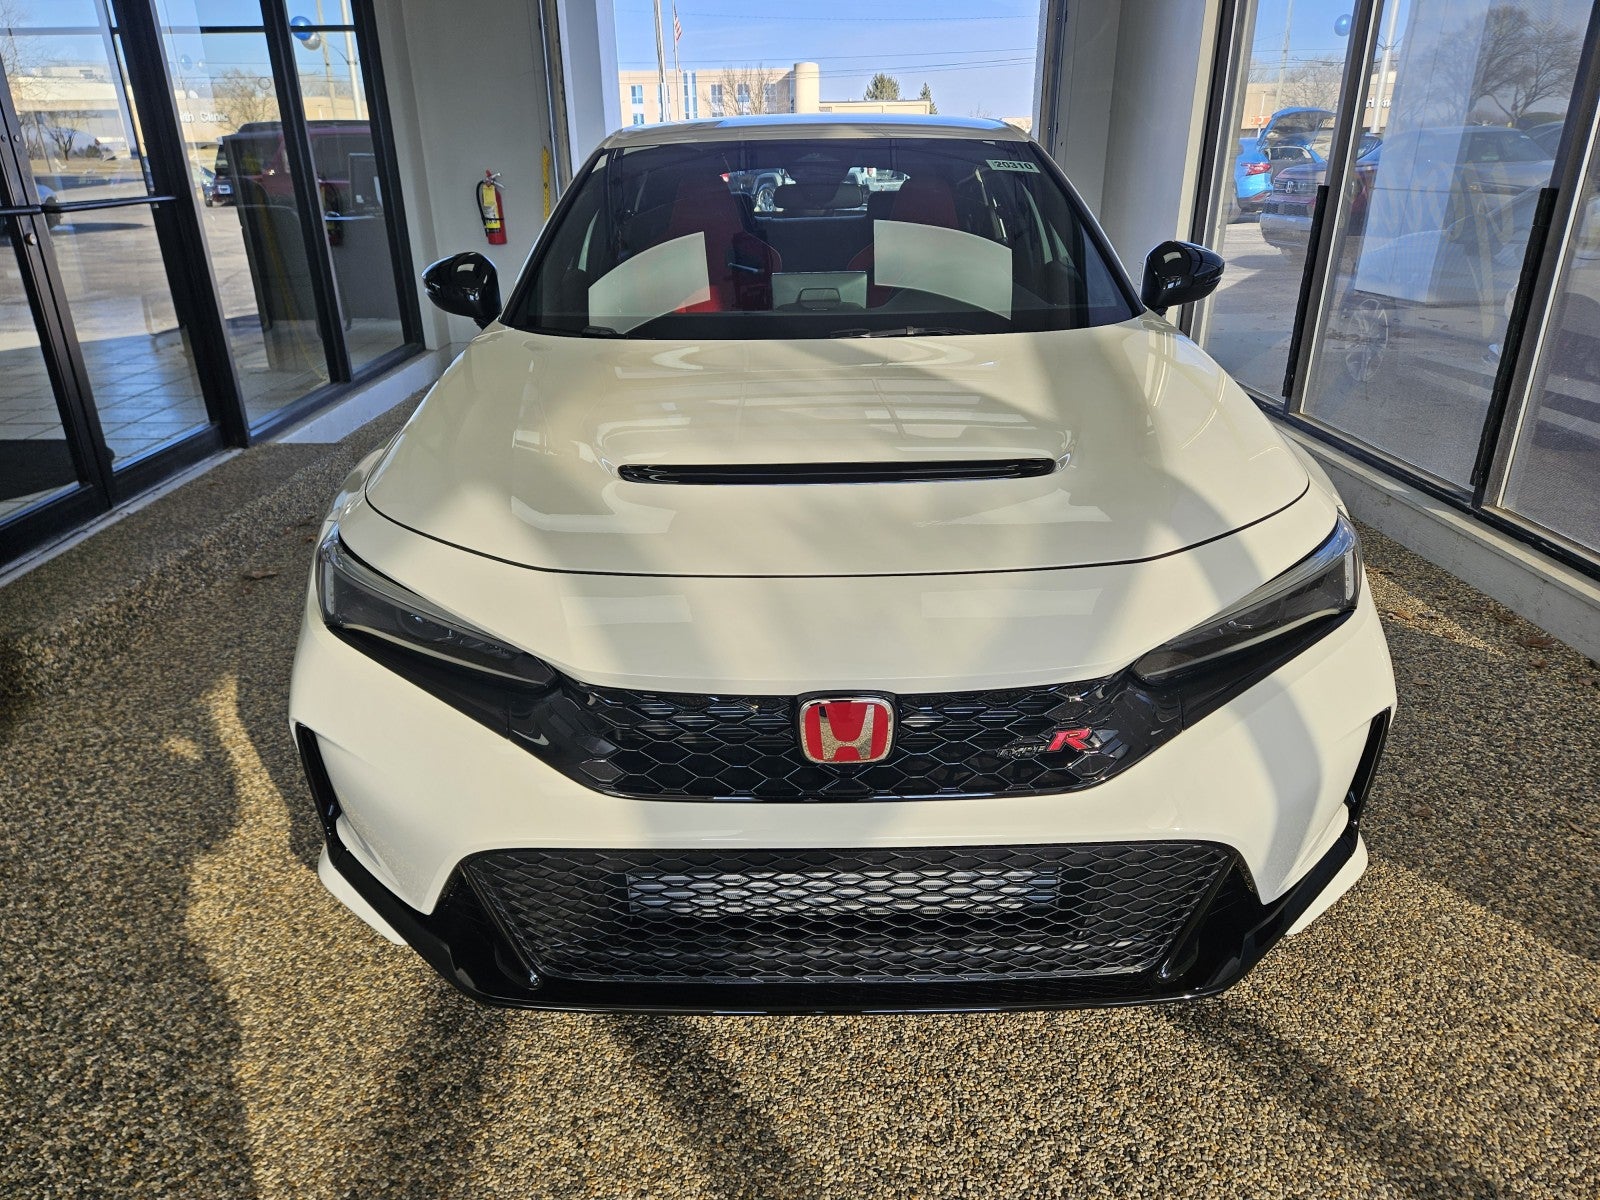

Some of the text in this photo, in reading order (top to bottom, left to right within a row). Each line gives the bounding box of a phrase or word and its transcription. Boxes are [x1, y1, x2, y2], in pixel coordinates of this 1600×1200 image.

[994, 161, 1033, 169] 20310
[818, 704, 875, 760] H
[1046, 728, 1091, 752] R
